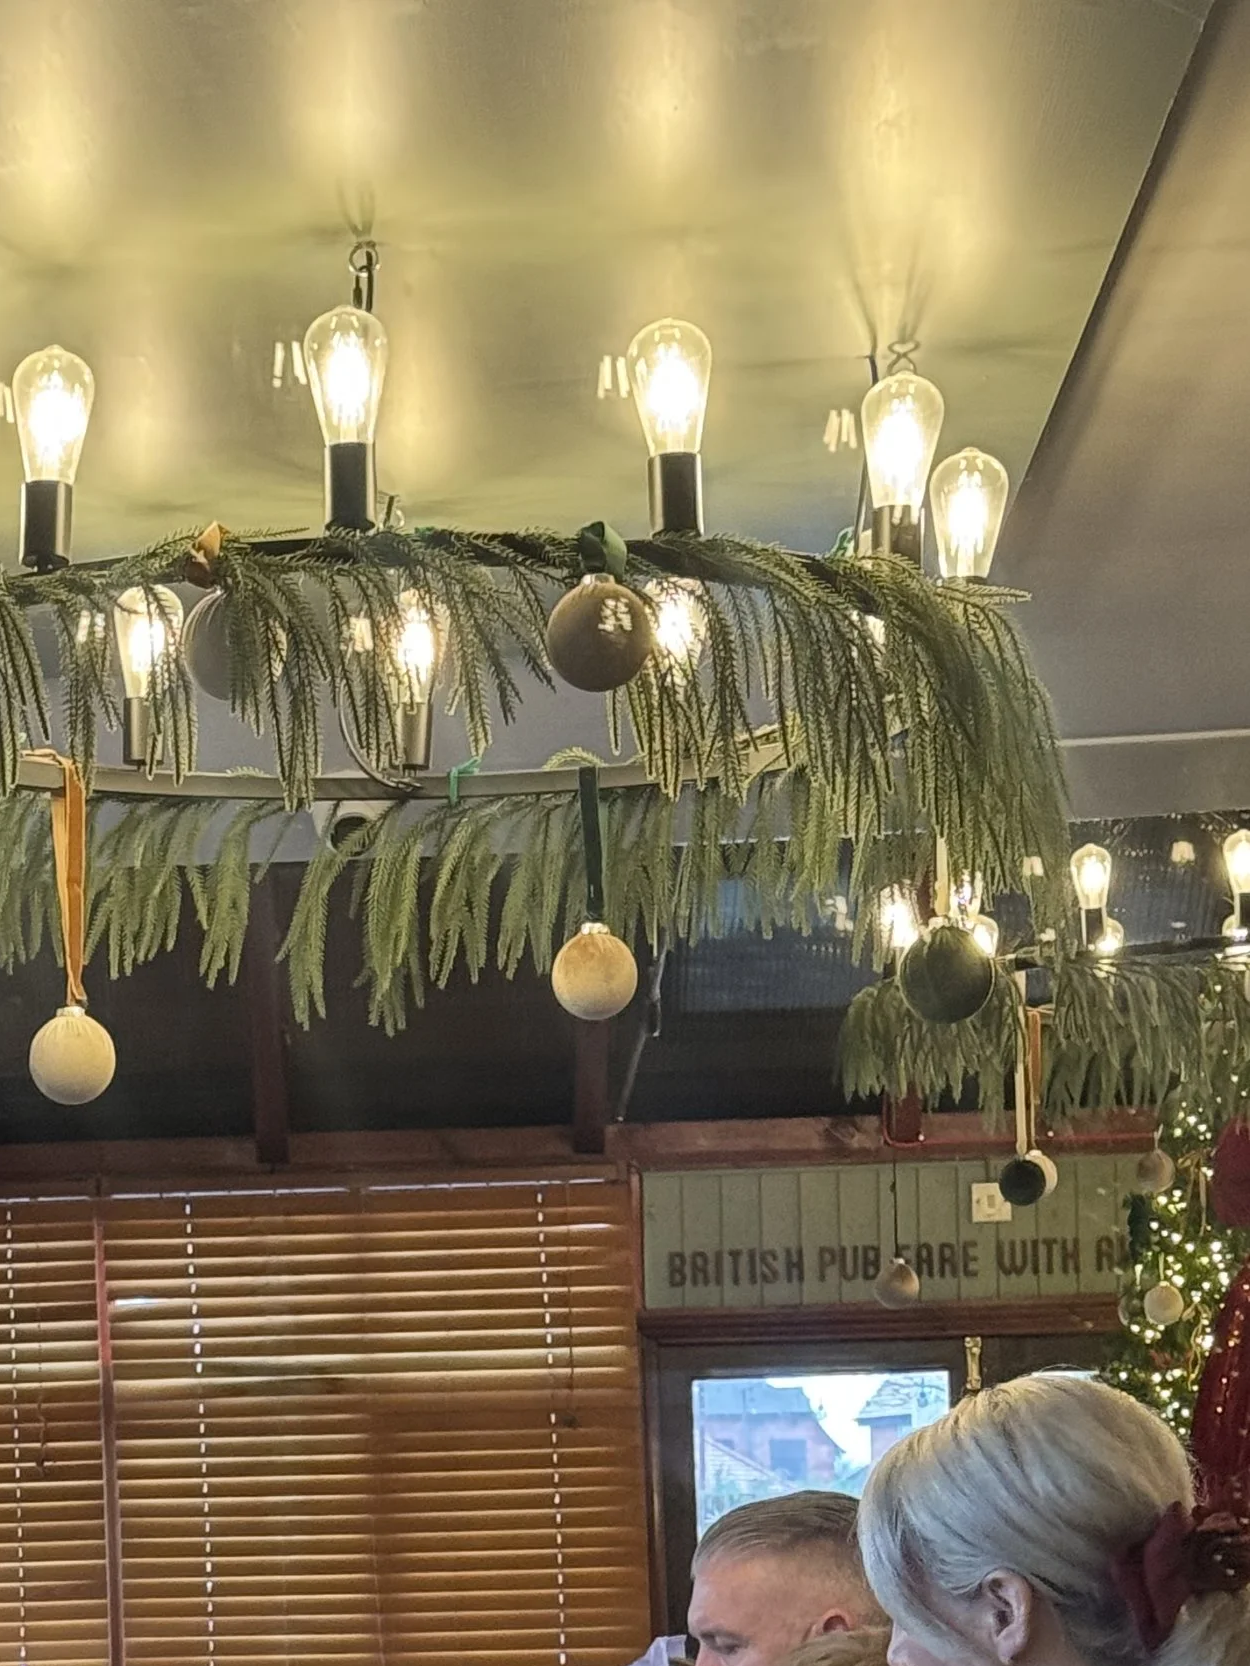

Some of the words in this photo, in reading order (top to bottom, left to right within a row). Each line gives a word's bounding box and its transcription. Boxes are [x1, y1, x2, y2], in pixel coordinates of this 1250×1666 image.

[669, 1248, 804, 1287] BRITISH
[818, 1244, 881, 1282] PUB
[997, 1236, 1080, 1276] WITH
